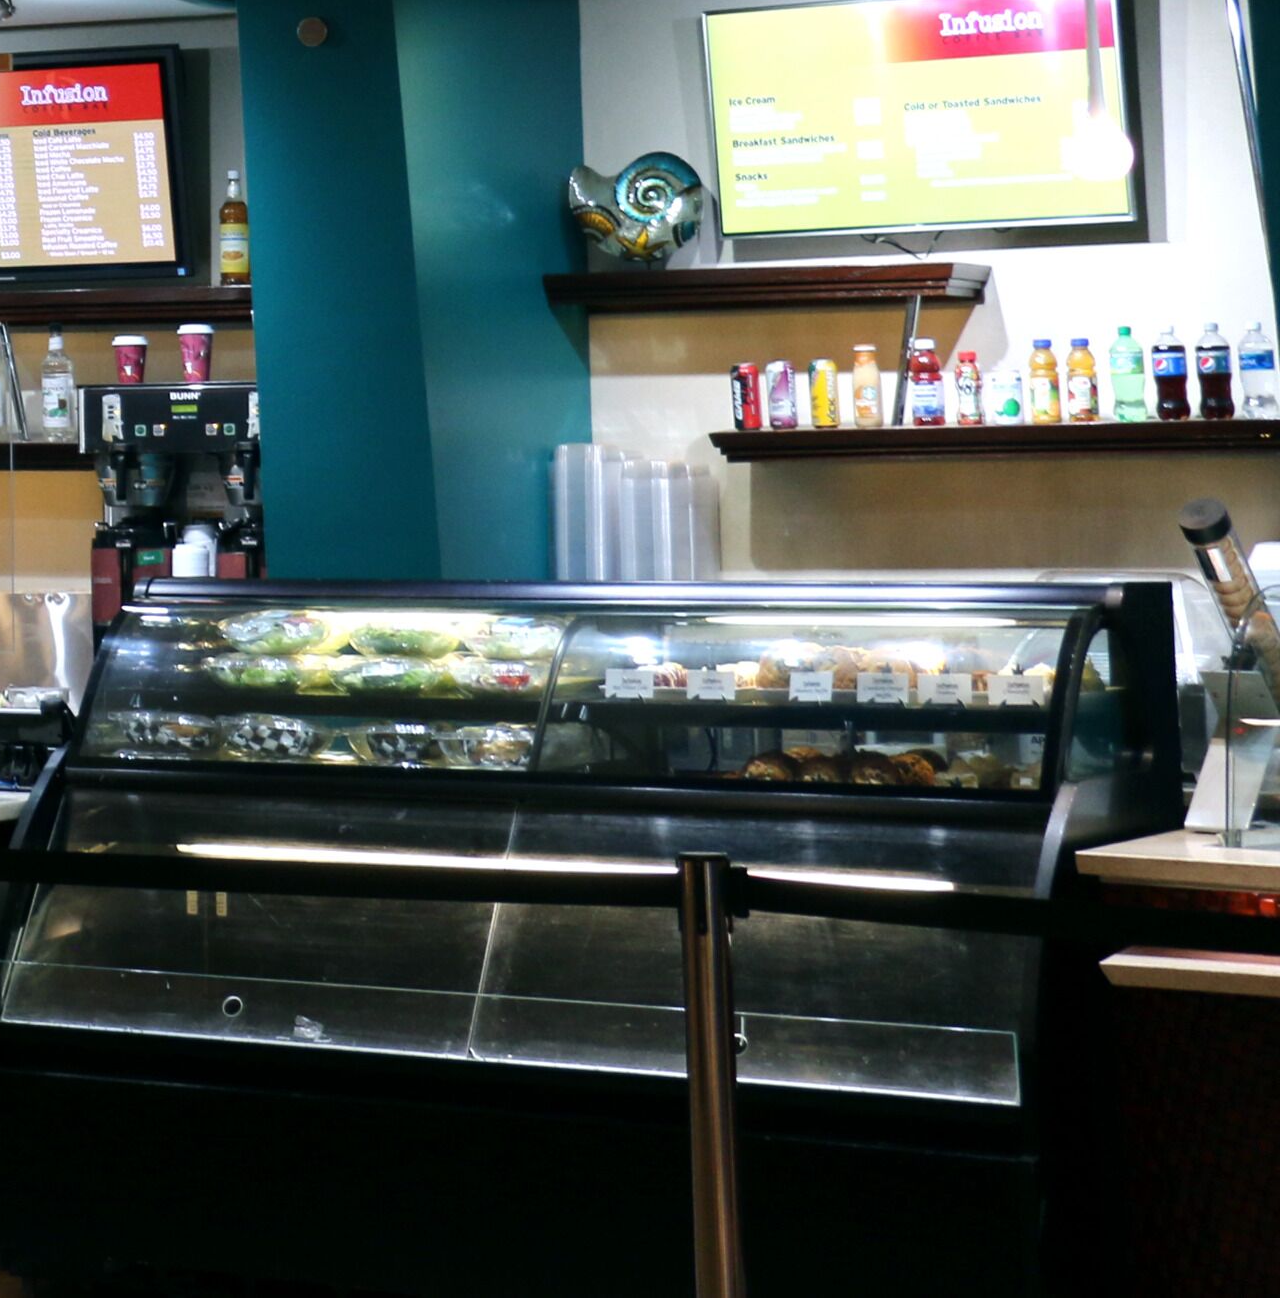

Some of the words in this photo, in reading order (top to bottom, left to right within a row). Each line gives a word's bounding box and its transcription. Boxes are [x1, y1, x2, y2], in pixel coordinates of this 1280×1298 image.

[939, 8, 1045, 37] Infusion
[20, 83, 108, 105] Infusion
[746, 97, 775, 105] Cream
[904, 103, 925, 111] Cold
[943, 100, 980, 108] Toasted
[984, 96, 1042, 106] Sandwiches
[54, 128, 96, 137] Beverages
[733, 137, 777, 148] Breakfast
[781, 135, 835, 145] Sandwiches
[735, 173, 767, 181] Snacks
[169, 392, 201, 400] BUNN
